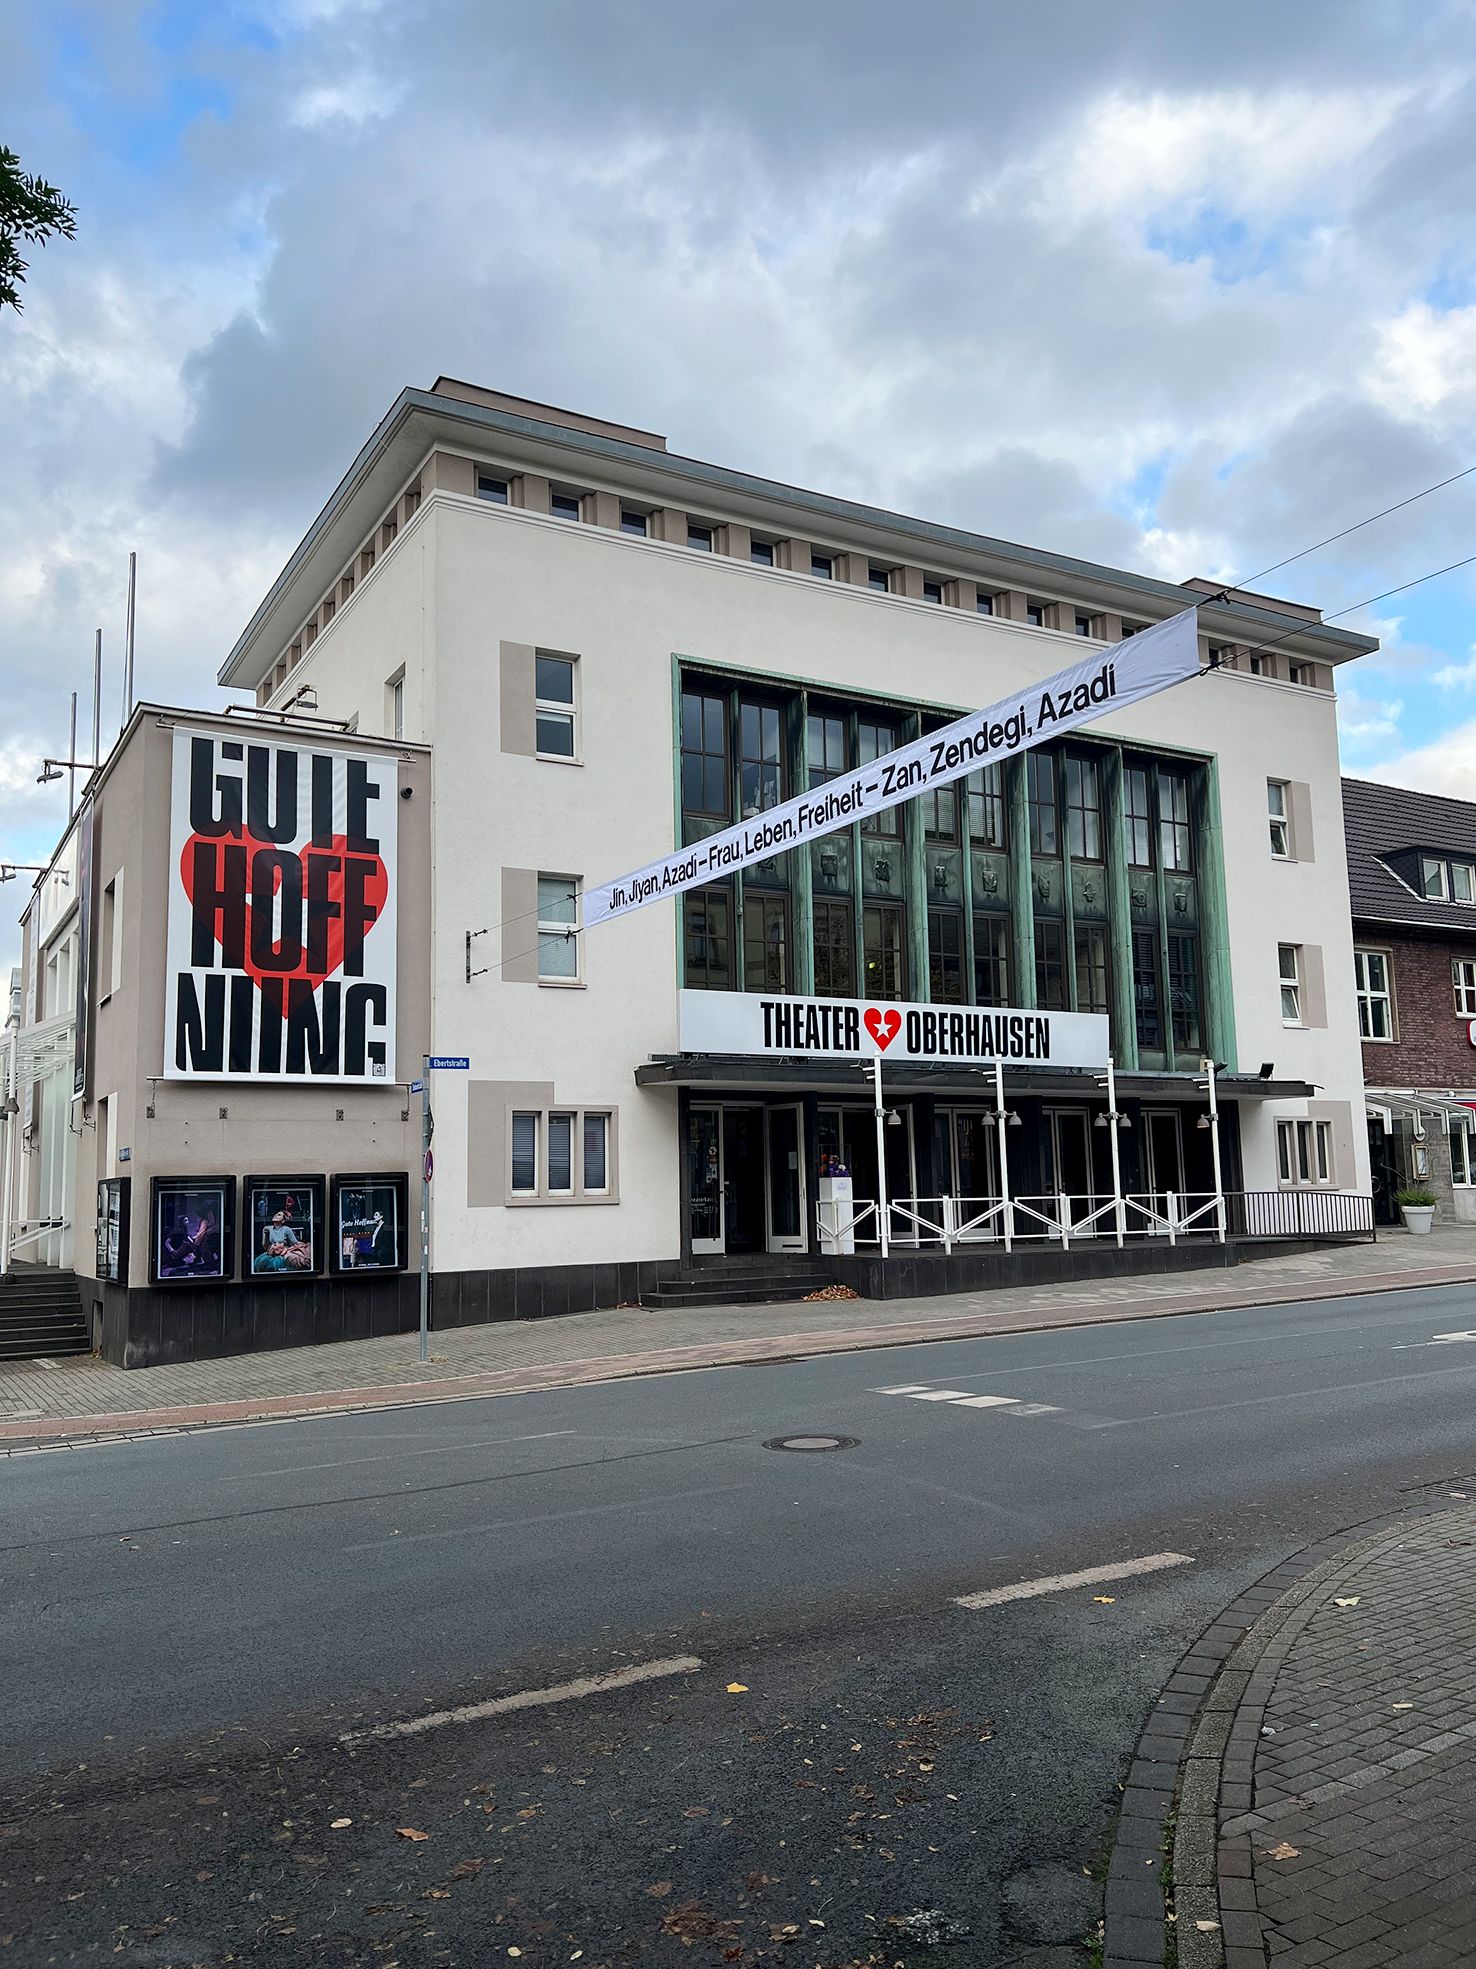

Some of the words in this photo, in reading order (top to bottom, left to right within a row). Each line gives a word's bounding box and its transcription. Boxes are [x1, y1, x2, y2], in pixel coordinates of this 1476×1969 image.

[609, 887, 628, 910] Jin,
[628, 874, 661, 904] Jiyan,
[709, 840, 744, 871] Frau,
[744, 818, 797, 856] Leben,
[799, 780, 864, 833] Freiheit
[881, 759, 927, 798] Zan,
[930, 704, 1032, 777] Zendegi,
[1037, 663, 1117, 729] Azadi
[190, 841, 378, 977] HOFF
[433, 1058, 467, 1068] Ebertstraße
[760, 1001, 861, 1051] THEATER
[906, 1010, 1051, 1060] OBERHAUSEN
